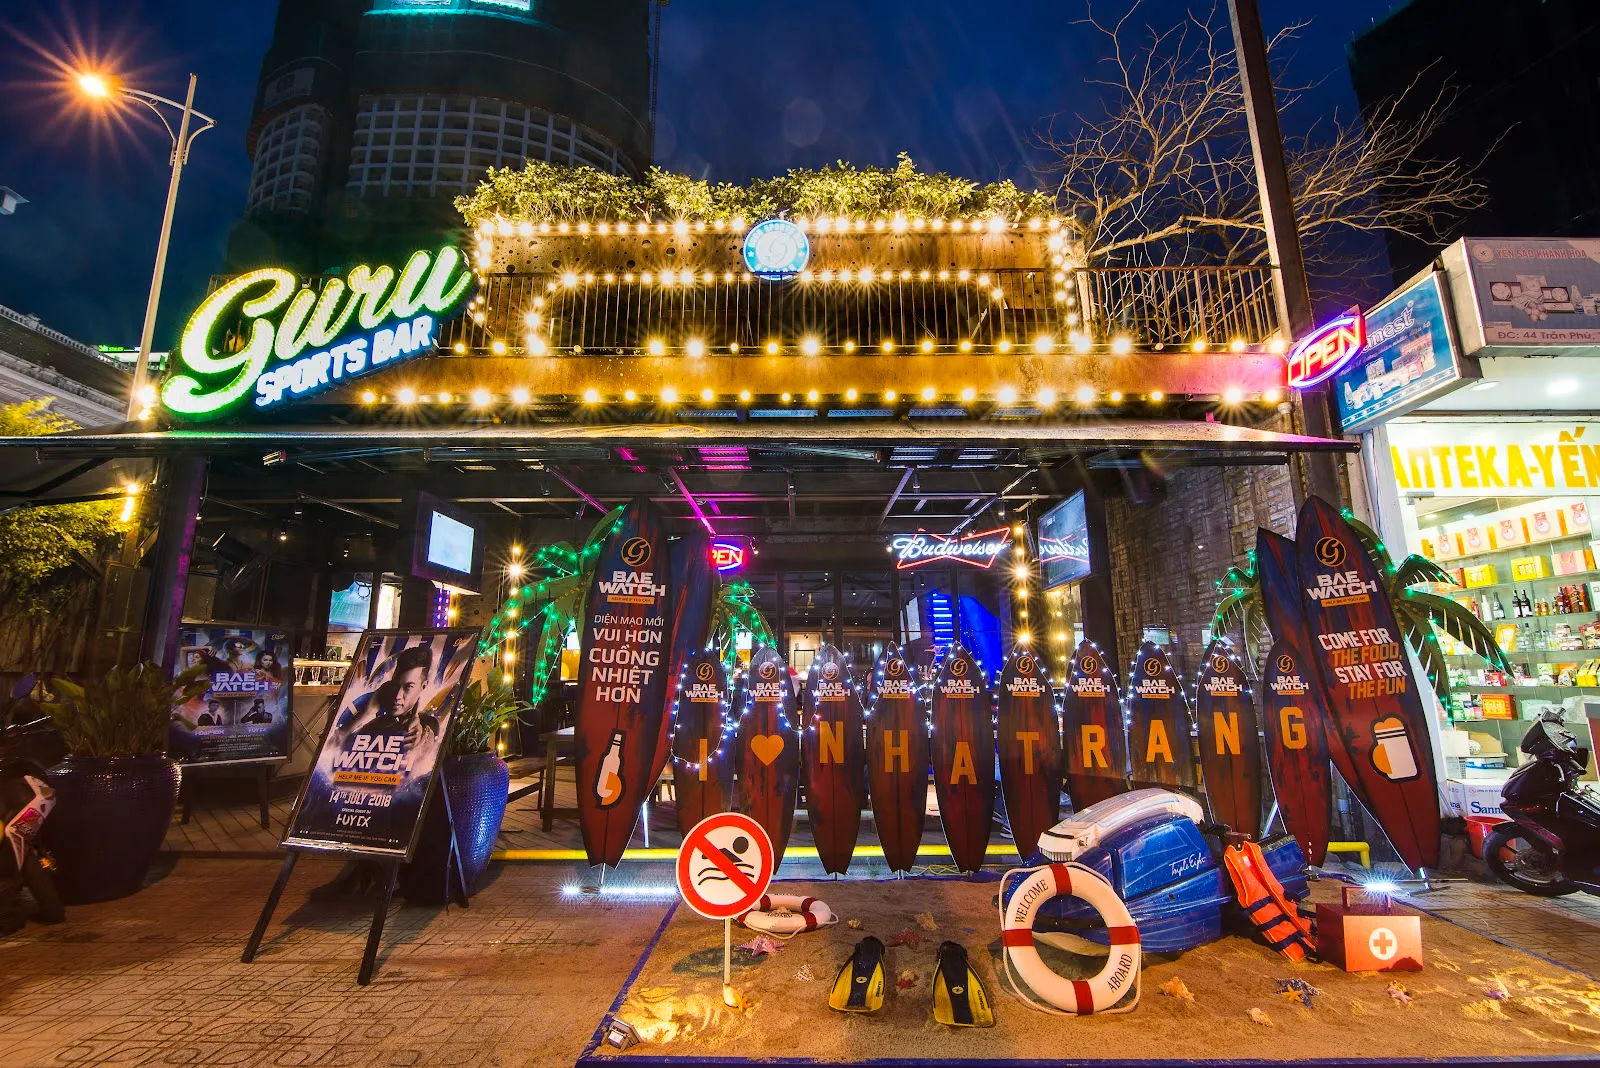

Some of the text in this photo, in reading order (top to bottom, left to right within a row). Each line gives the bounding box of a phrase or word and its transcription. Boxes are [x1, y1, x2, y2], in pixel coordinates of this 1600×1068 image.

[162, 246, 472, 414] Guru
[1523, 331, 1537, 339] 44
[1288, 315, 1361, 386] OPEN
[255, 315, 433, 407] SPORTS BAR
[893, 536, 1010, 559] Budweiser
[612, 570, 653, 584] BAE
[1316, 570, 1360, 587] BAE
[599, 581, 666, 597] WATCH
[1307, 580, 1377, 600] WATCH
[645, 614, 664, 626] MỚI
[593, 628, 663, 644] VUI HƠN
[1318, 628, 1393, 650] COME FOR
[1332, 648, 1359, 667] THE
[215, 672, 256, 682] BAE
[592, 664, 653, 689] NHIỆT
[1210, 676, 1234, 684] BAE
[1276, 675, 1300, 683] BAE
[1334, 661, 1407, 684] STAY FOR
[692, 683, 717, 691] BAE
[1006, 683, 1046, 693] WATCH
[1013, 677, 1038, 685] BAE
[1071, 684, 1111, 693] WATCH
[1078, 677, 1102, 685] BAE
[1142, 679, 1166, 687] BAE
[1203, 682, 1242, 692] WATCH
[1270, 682, 1309, 691] WATCH
[1348, 676, 1405, 699] THE FUN
[595, 686, 641, 704] HƠN
[685, 689, 724, 698] WATCH
[811, 688, 850, 697] WATCH
[877, 686, 916, 694] WATCH
[940, 685, 980, 694] WATCH
[1135, 685, 1175, 694] WATCH
[352, 734, 405, 753] BAE
[333, 751, 415, 772] WATCH
[699, 738, 708, 781] I
[345, 791, 368, 805] JULY
[368, 794, 392, 807] 2018
[1471, 801, 1503, 814] Sann
[1168, 857, 1189, 876] Triple
[1015, 879, 1049, 924] WELCOME
[1107, 953, 1132, 993] ABOARD
